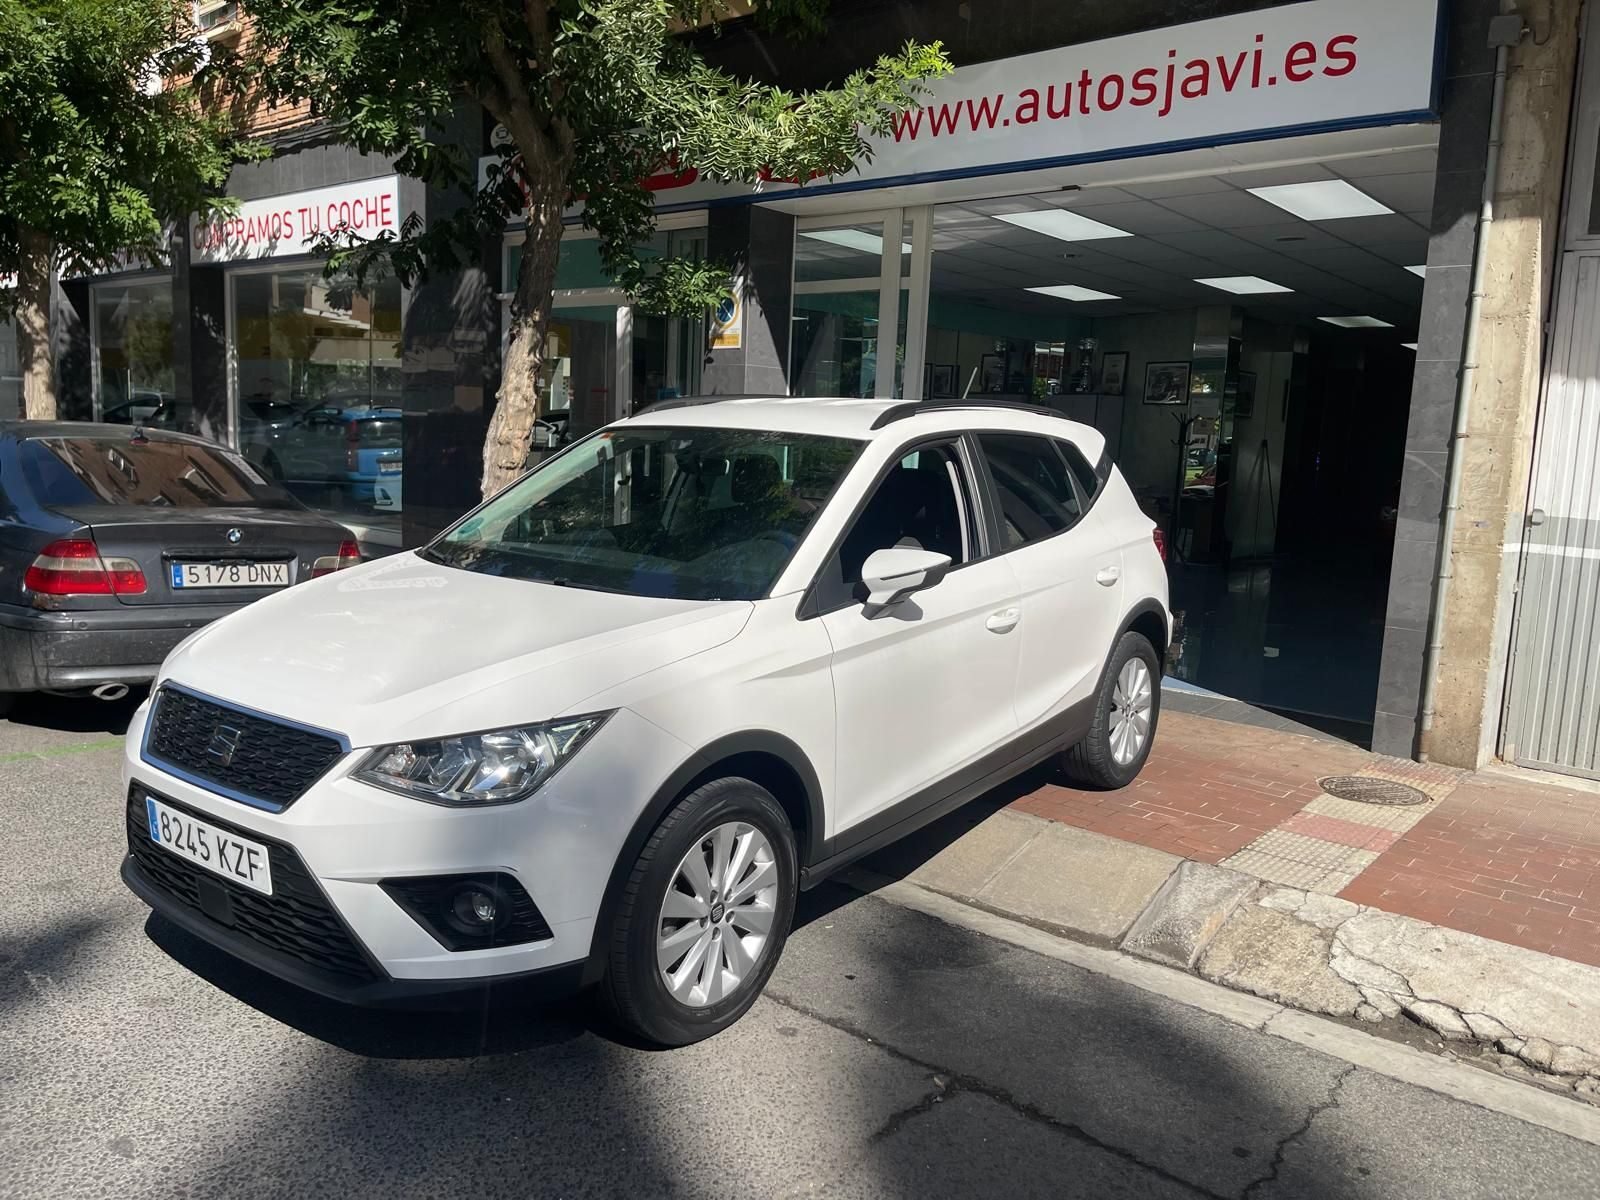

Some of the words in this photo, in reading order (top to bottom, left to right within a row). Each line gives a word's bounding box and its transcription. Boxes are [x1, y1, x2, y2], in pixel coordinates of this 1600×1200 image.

[892, 34, 1359, 141] www.autosjavi.es
[193, 210, 293, 250] COMPRAMOS
[298, 206, 320, 237] TU
[327, 194, 392, 234] COCHE
[188, 565, 240, 583] 5178
[248, 565, 283, 582] DNX
[160, 811, 210, 862] 8245
[216, 835, 260, 881] KZF
